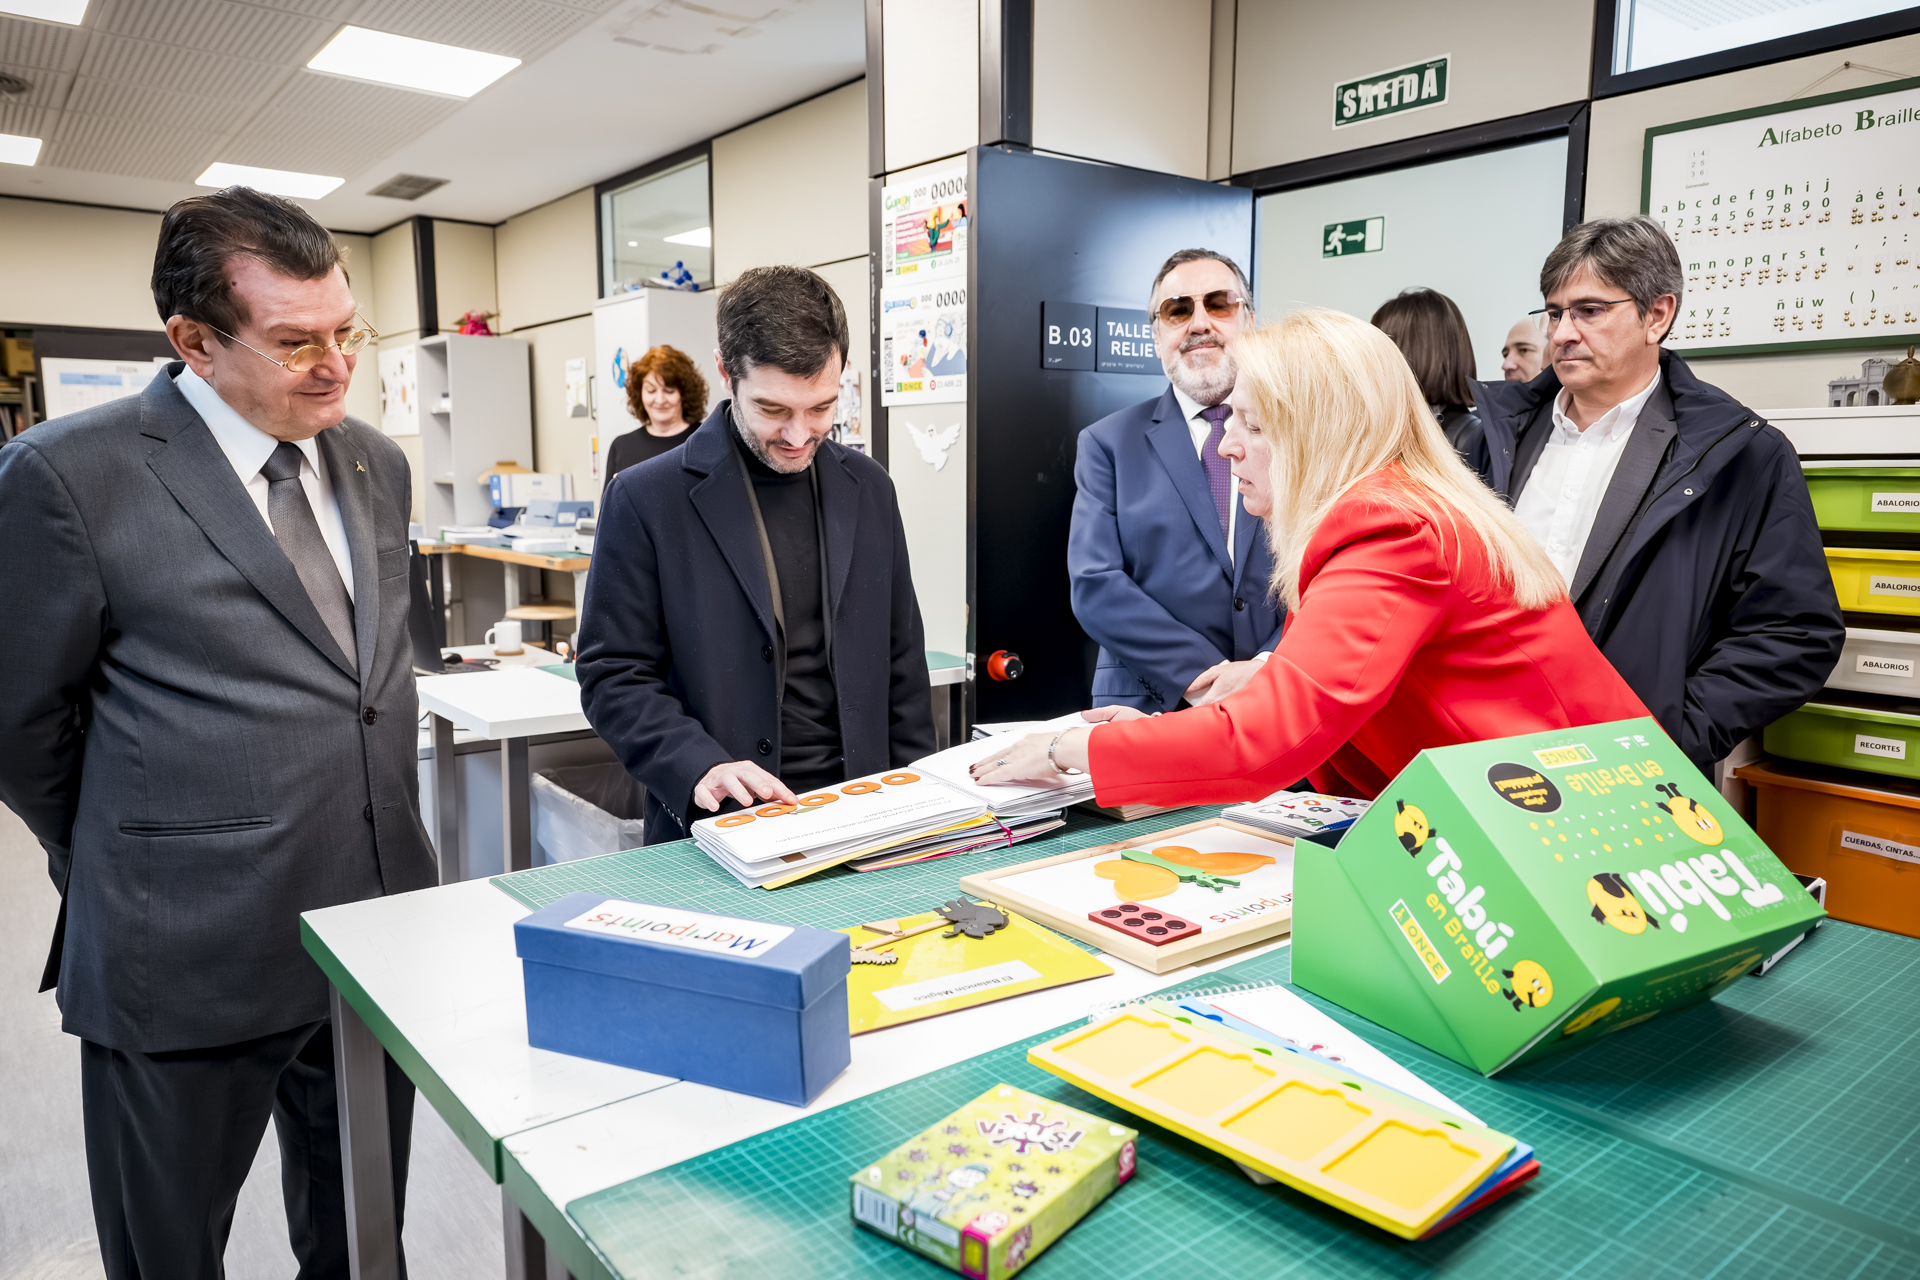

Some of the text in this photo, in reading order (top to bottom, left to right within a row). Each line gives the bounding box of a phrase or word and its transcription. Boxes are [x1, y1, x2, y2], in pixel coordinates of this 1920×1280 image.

[1343, 67, 1437, 118] SALIDA
[1757, 108, 1920, 149] Alfabeto Braille
[1661, 178, 1829, 214] a b c d e f g h i j
[1855, 185, 1903, 202] á é í
[1678, 218, 1684, 228] 2
[1695, 216, 1701, 225] 3
[1711, 213, 1718, 223] 4
[1729, 211, 1736, 220] 5
[1747, 208, 1754, 218] 6
[1767, 205, 1774, 215] 7
[1783, 203, 1791, 213] 8
[1802, 200, 1809, 210] 9
[1689, 247, 1825, 270] m n o p q r s t
[1690, 309, 1696, 317] x
[1707, 308, 1713, 318] y
[1777, 298, 1824, 309] ñ ü w
[1048, 325, 1092, 347] B.03
[1106, 322, 1154, 338] TALLE
[1111, 340, 1156, 357] RELIE
[1863, 660, 1910, 671] ABALORIOS
[1860, 741, 1901, 753] RECORTES
[1565, 760, 1664, 796] en Braille
[1844, 836, 1883, 851] CUERDAS,
[1426, 837, 1515, 960] Tabú
[1627, 848, 1784, 933] Tabú
[587, 913, 768, 951] Maripoints
[1426, 893, 1500, 994] en Braille
[1408, 925, 1444, 976] ONCE
